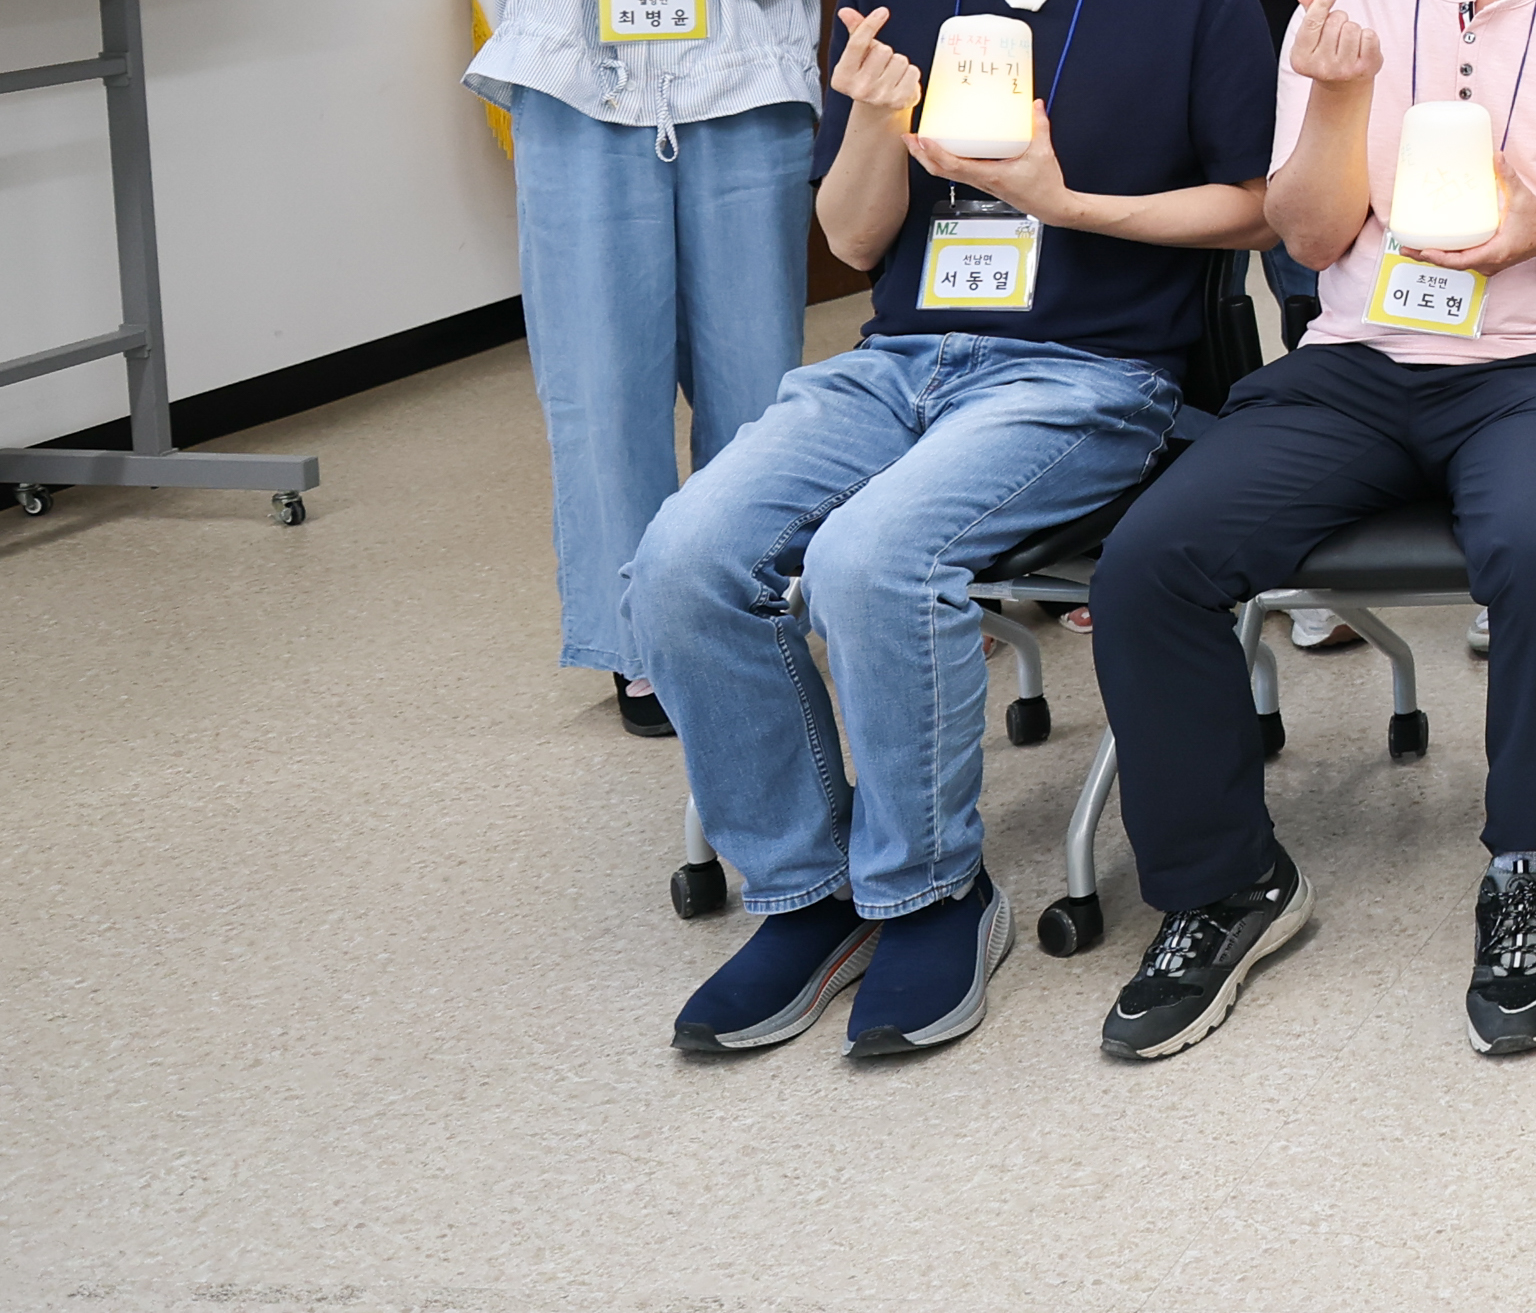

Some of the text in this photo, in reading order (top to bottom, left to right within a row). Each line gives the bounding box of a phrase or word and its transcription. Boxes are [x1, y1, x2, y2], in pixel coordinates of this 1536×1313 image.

[935, 222, 959, 236] MZ
[962, 254, 993, 266] 선남면
[1416, 274, 1448, 290] 초전면
